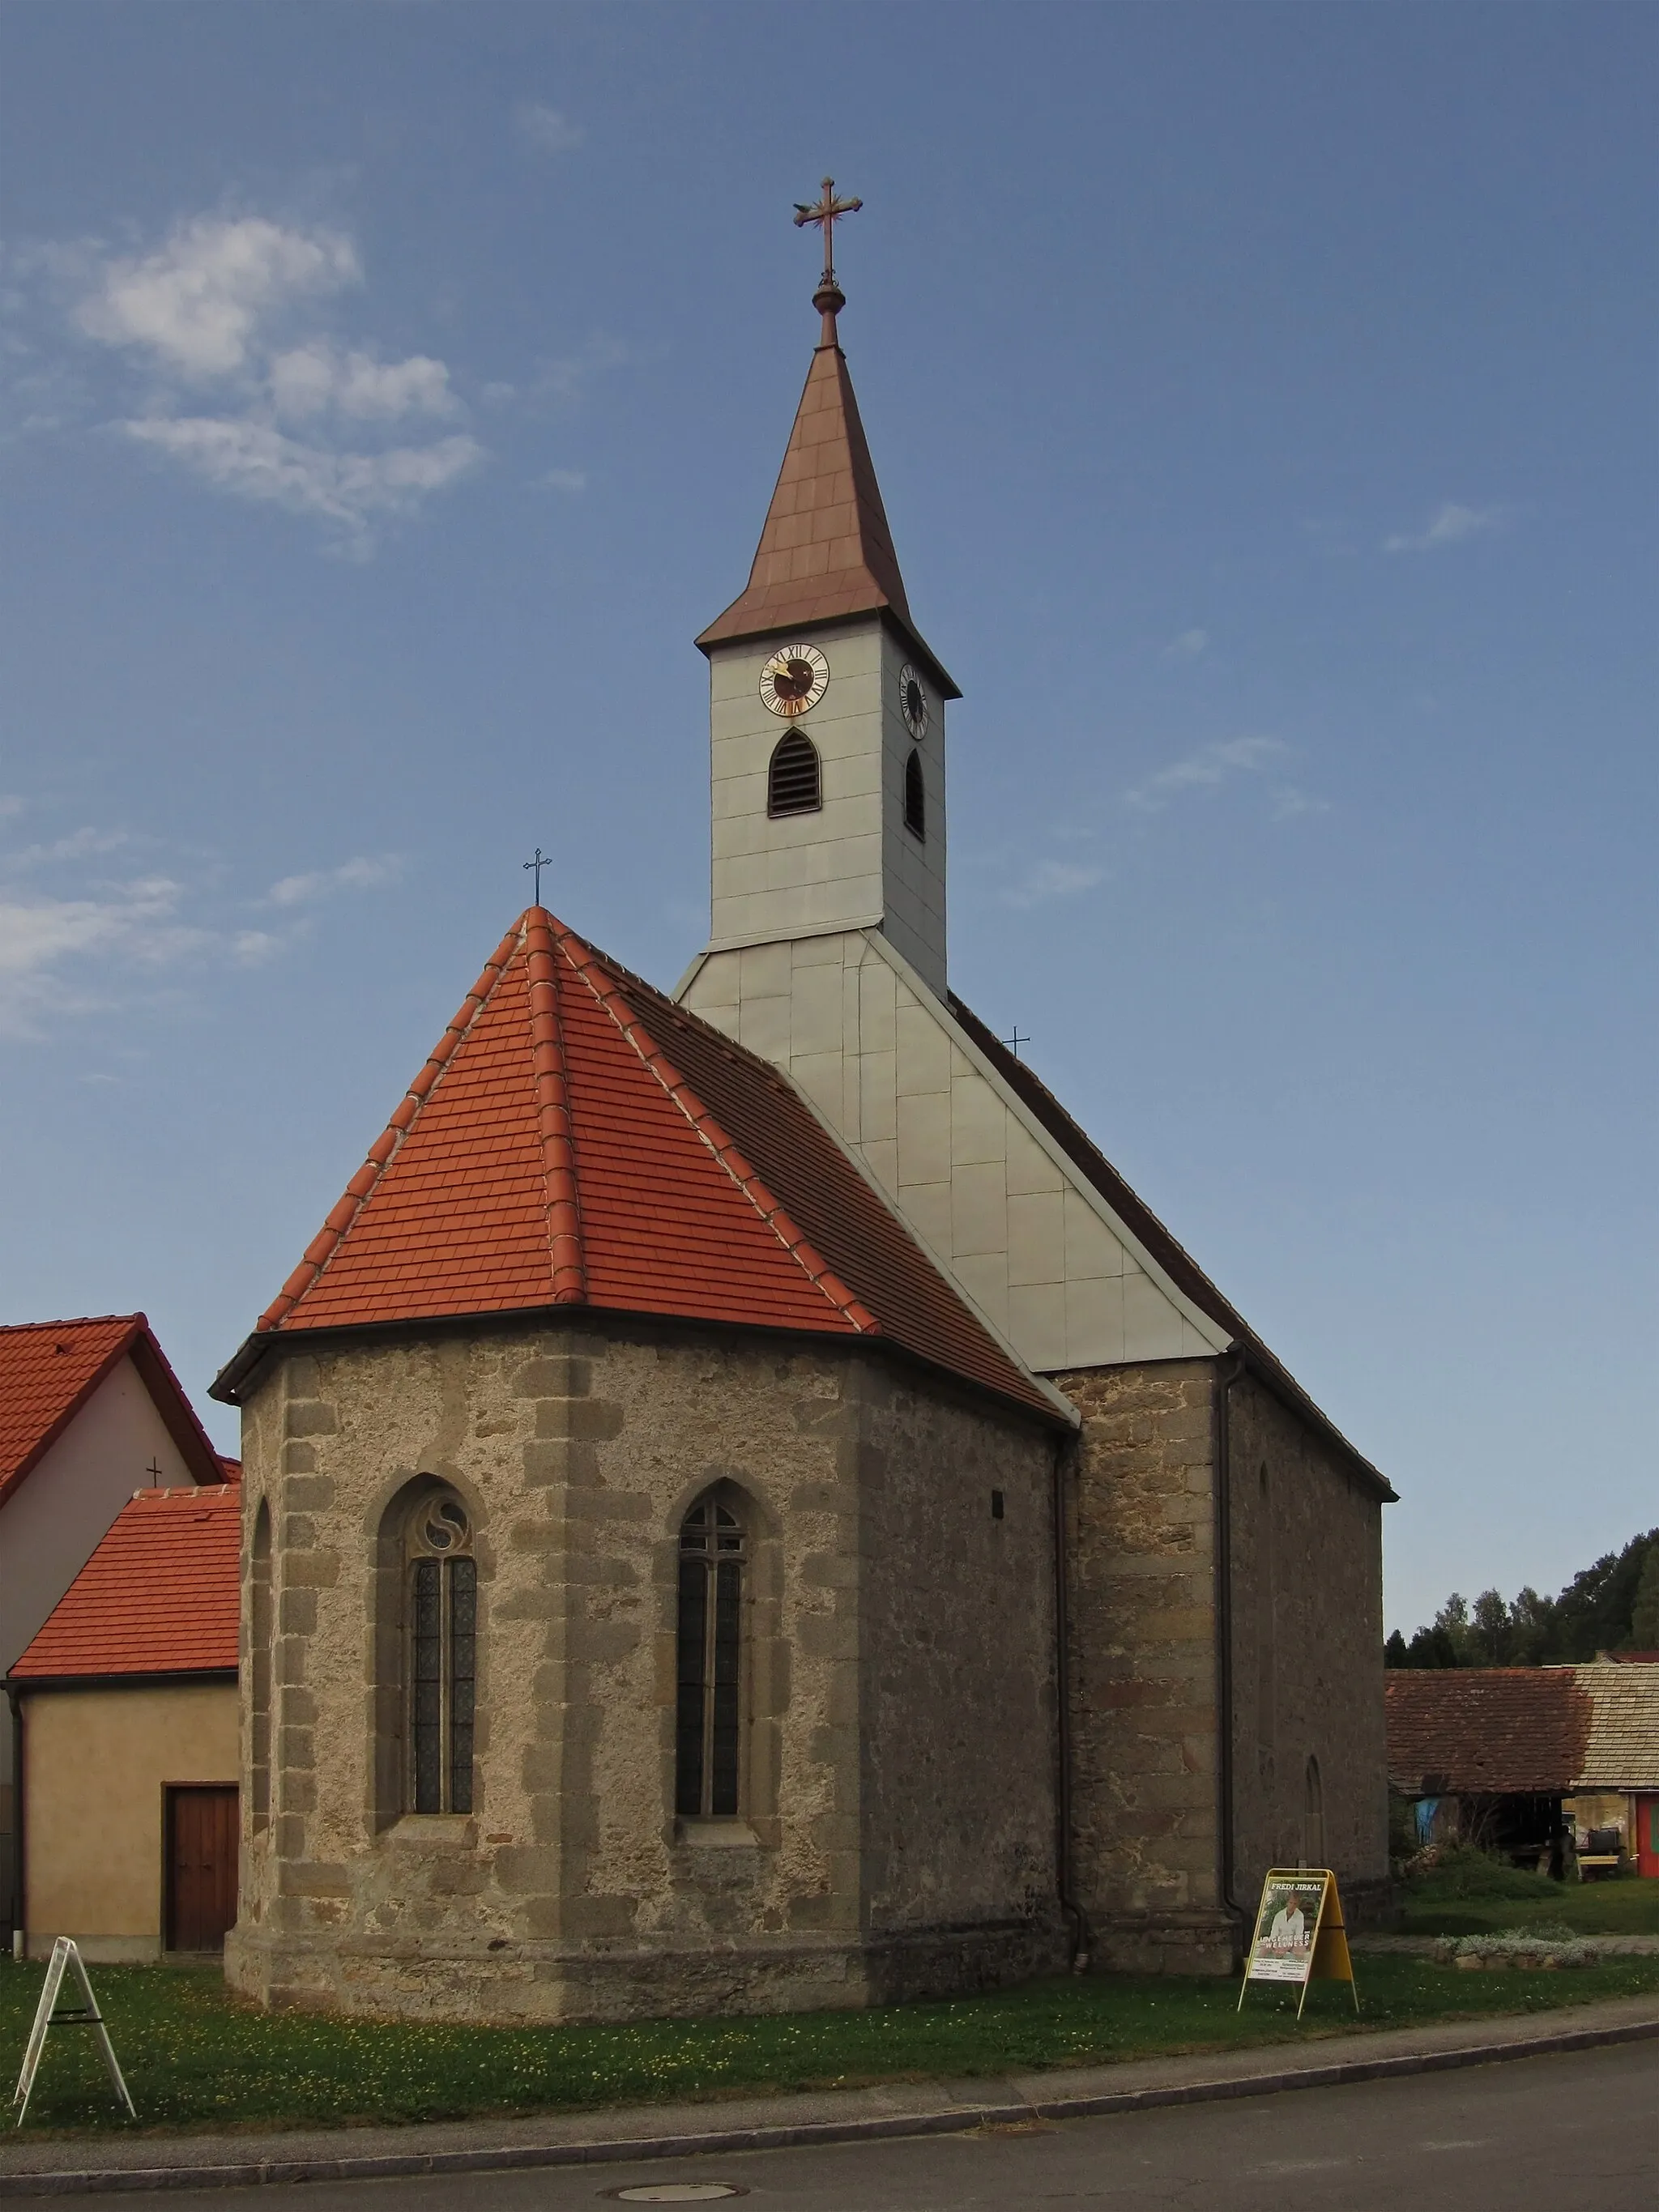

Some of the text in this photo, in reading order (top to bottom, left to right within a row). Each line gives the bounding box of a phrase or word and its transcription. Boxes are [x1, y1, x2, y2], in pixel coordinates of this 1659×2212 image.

[788, 645, 802, 659] XII
[815, 669, 827, 680] III
[1295, 1883, 1321, 1891] JIRKAL
[1260, 1933, 1310, 1942] UNGEHEUER
[1265, 1940, 1309, 1948] WELLNESS
